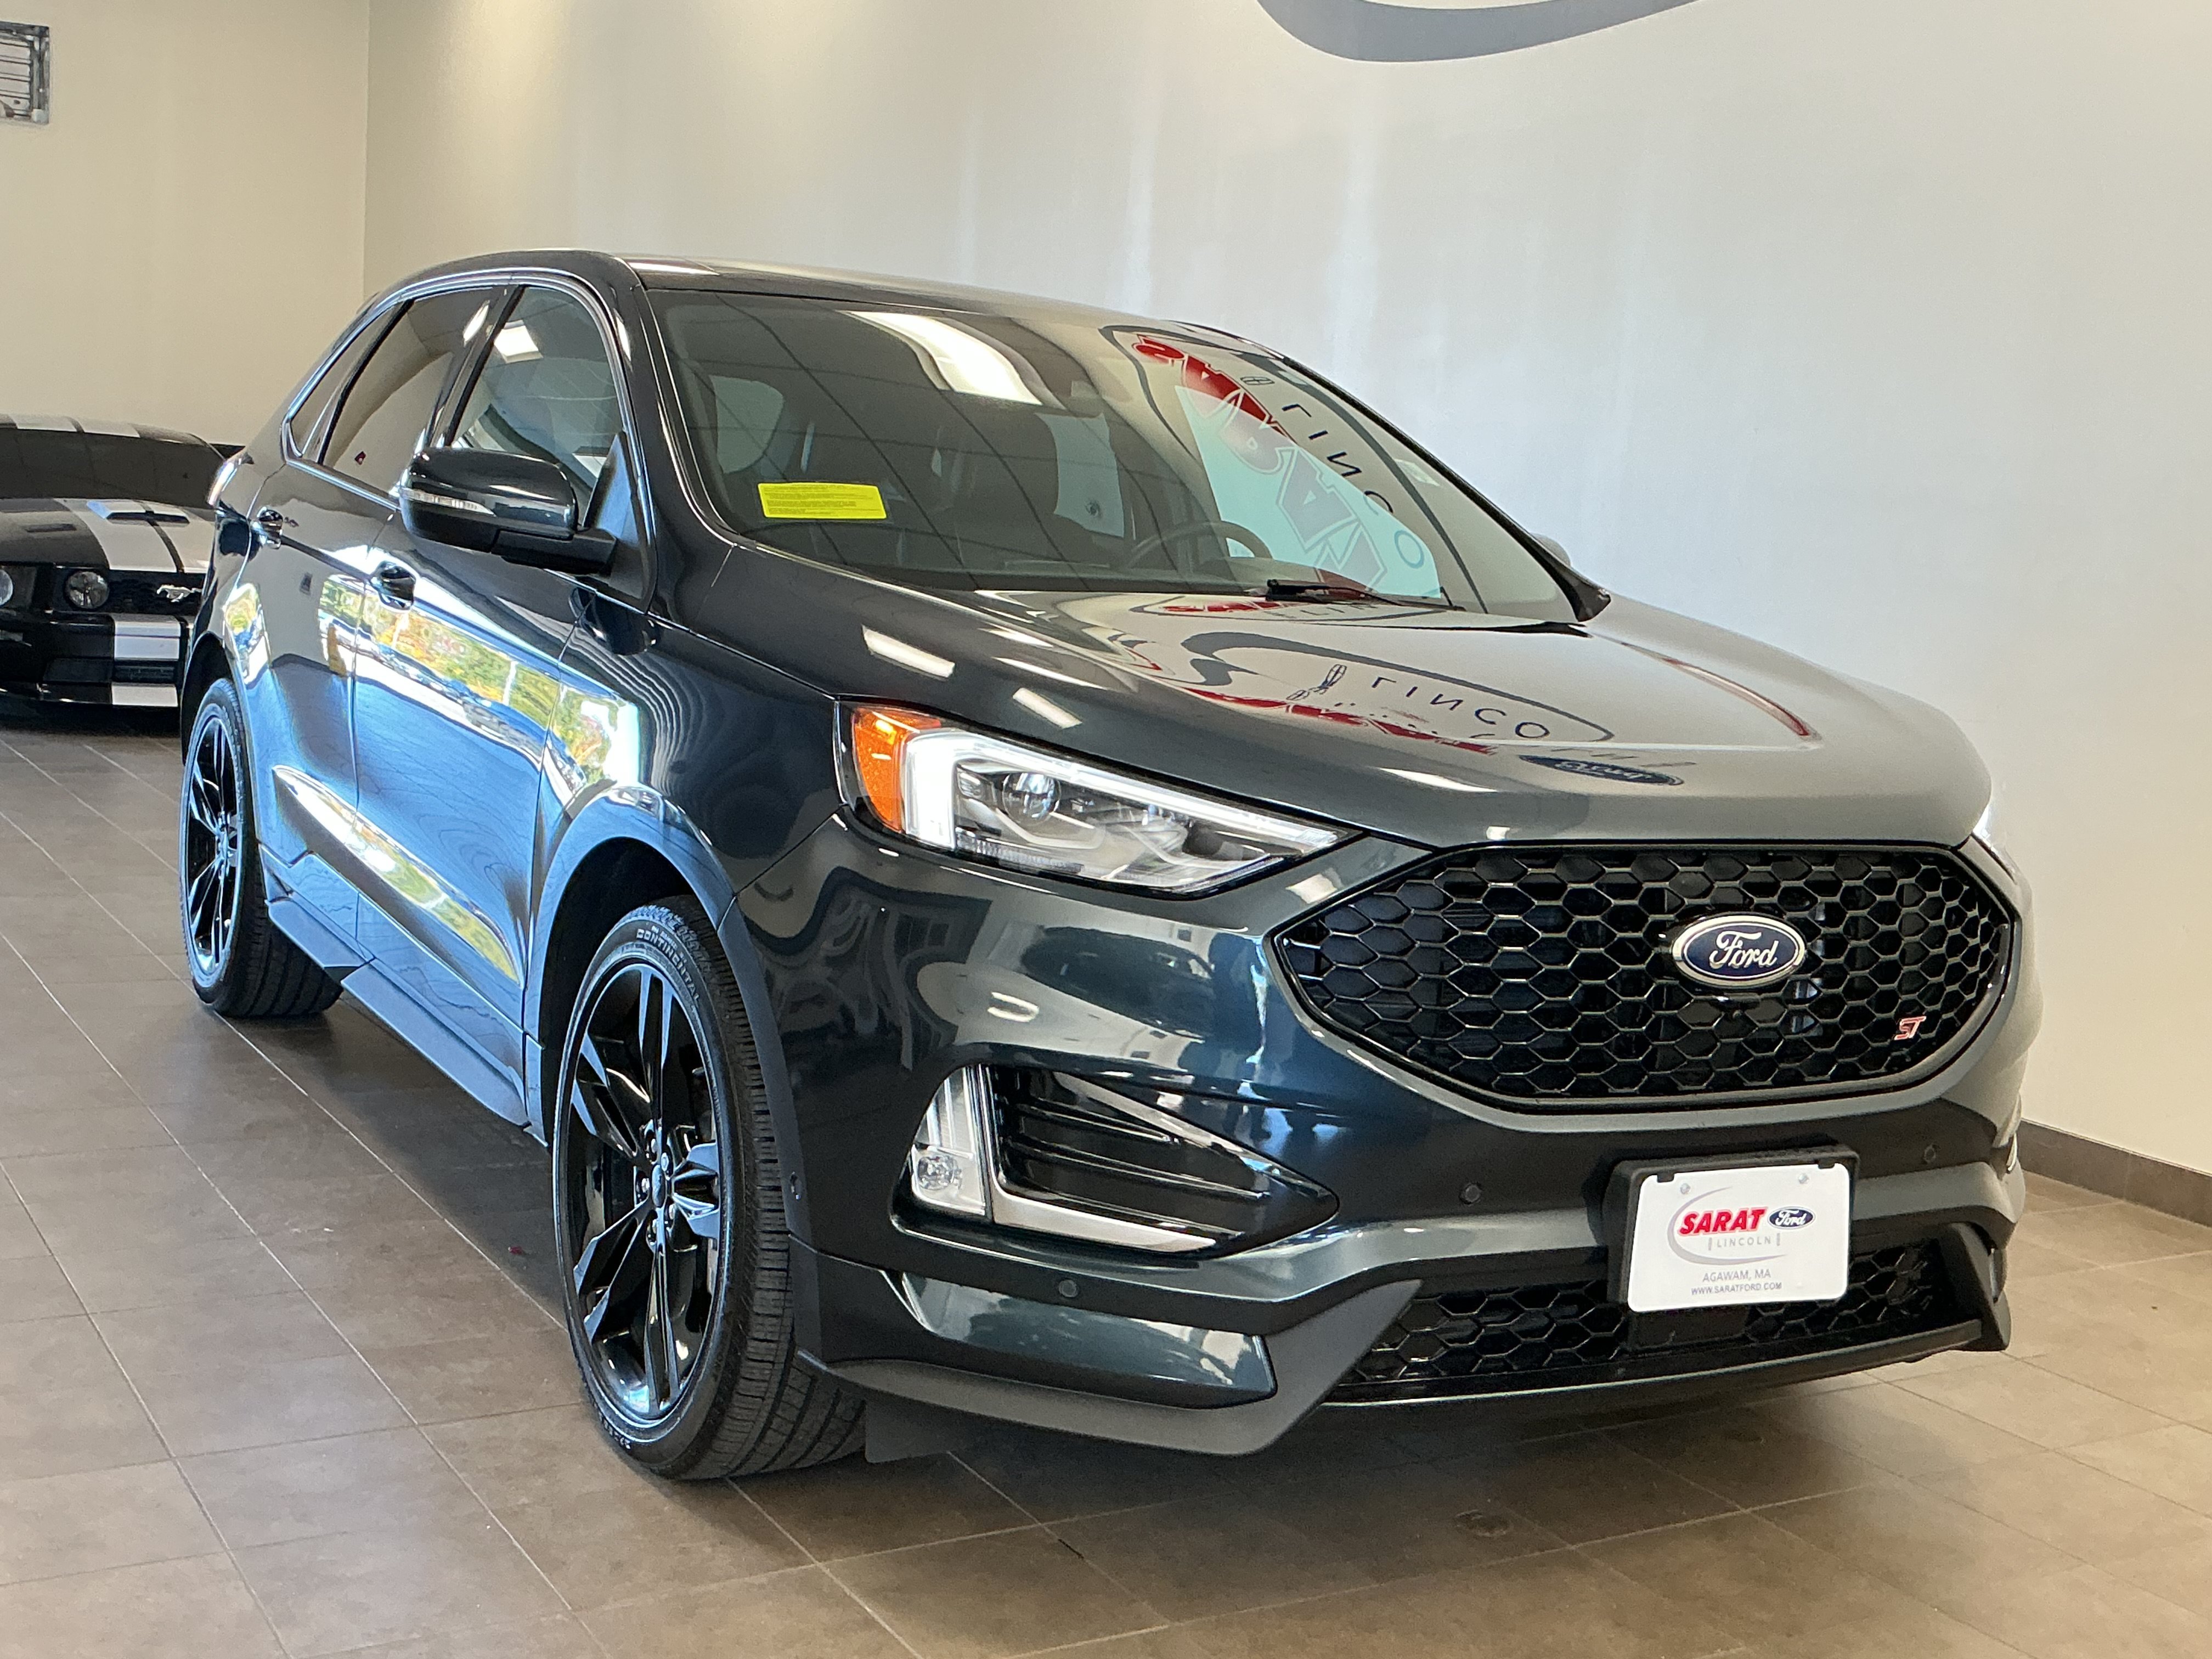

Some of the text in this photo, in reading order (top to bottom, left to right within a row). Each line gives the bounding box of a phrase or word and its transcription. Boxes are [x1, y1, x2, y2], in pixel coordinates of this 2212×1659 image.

[1709, 930, 1780, 969] Ford
[1894, 1015, 1927, 1040] ST
[1678, 1207, 1807, 1237] SARAT Ford
[1717, 1236, 1771, 1248] LINCOLN
[1702, 1268, 1771, 1282] AGAWAM, MA
[1691, 1282, 1782, 1295] WWW.SARATFORD.COM
